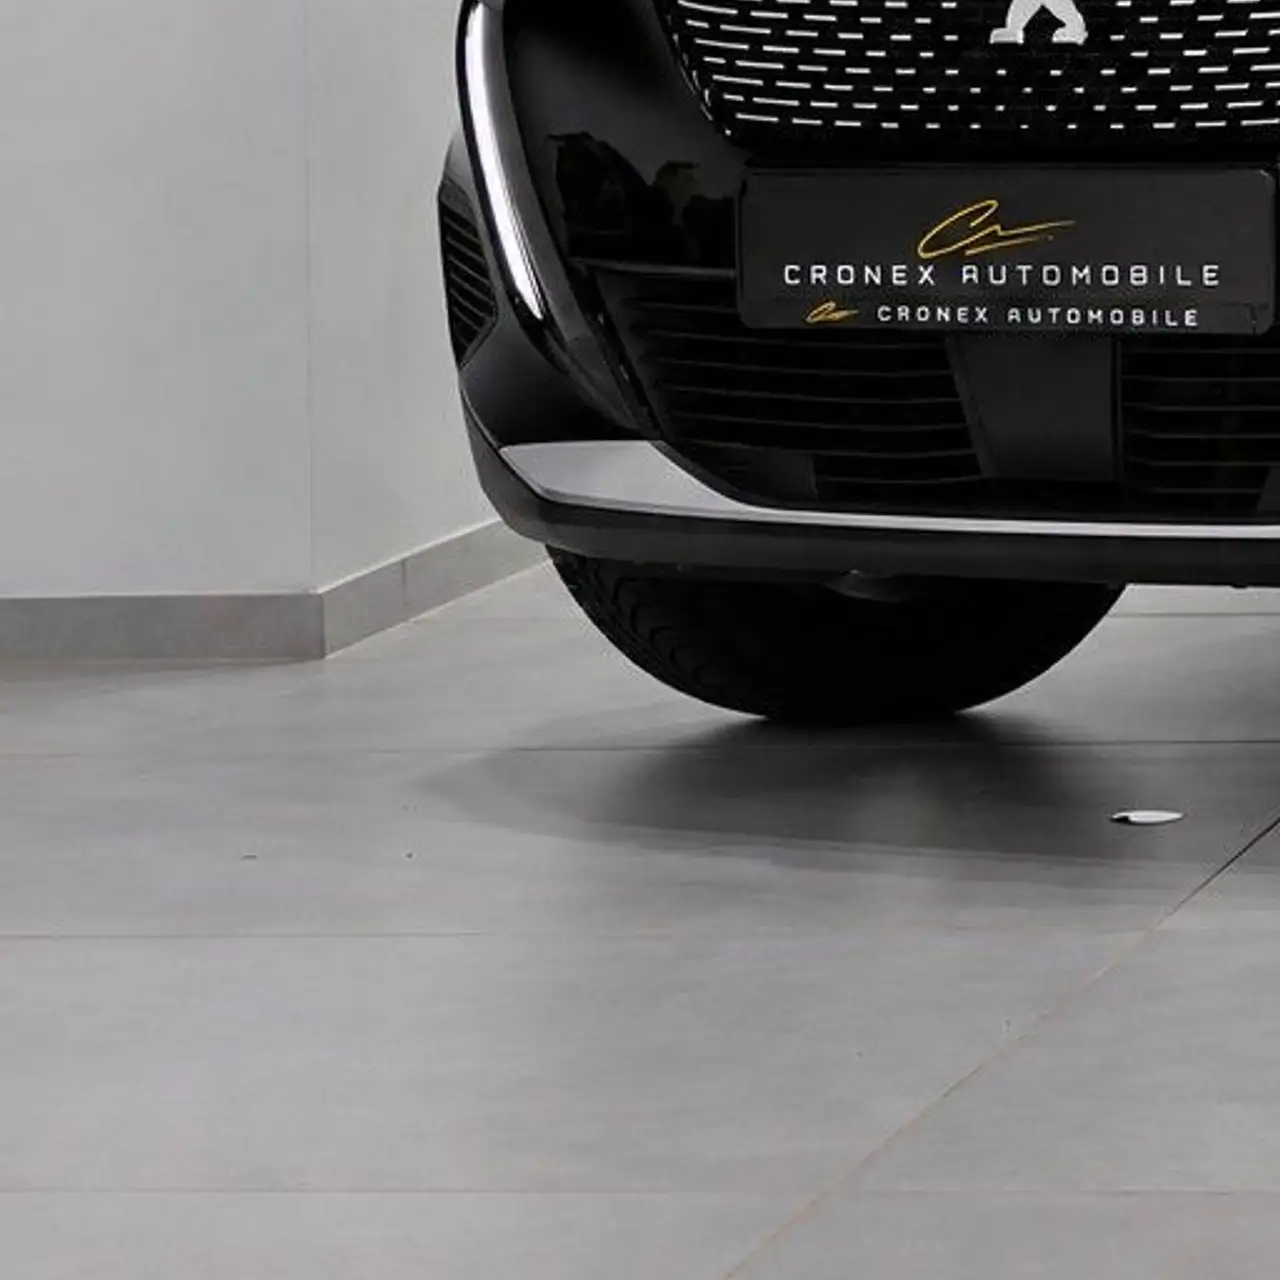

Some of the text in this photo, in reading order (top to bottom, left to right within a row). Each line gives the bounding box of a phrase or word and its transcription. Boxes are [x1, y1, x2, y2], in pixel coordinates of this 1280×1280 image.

[783, 263, 1221, 287] CRONEX AUTOMOBILE
[877, 305, 1199, 327] CRONEX AUTOMOBILE
